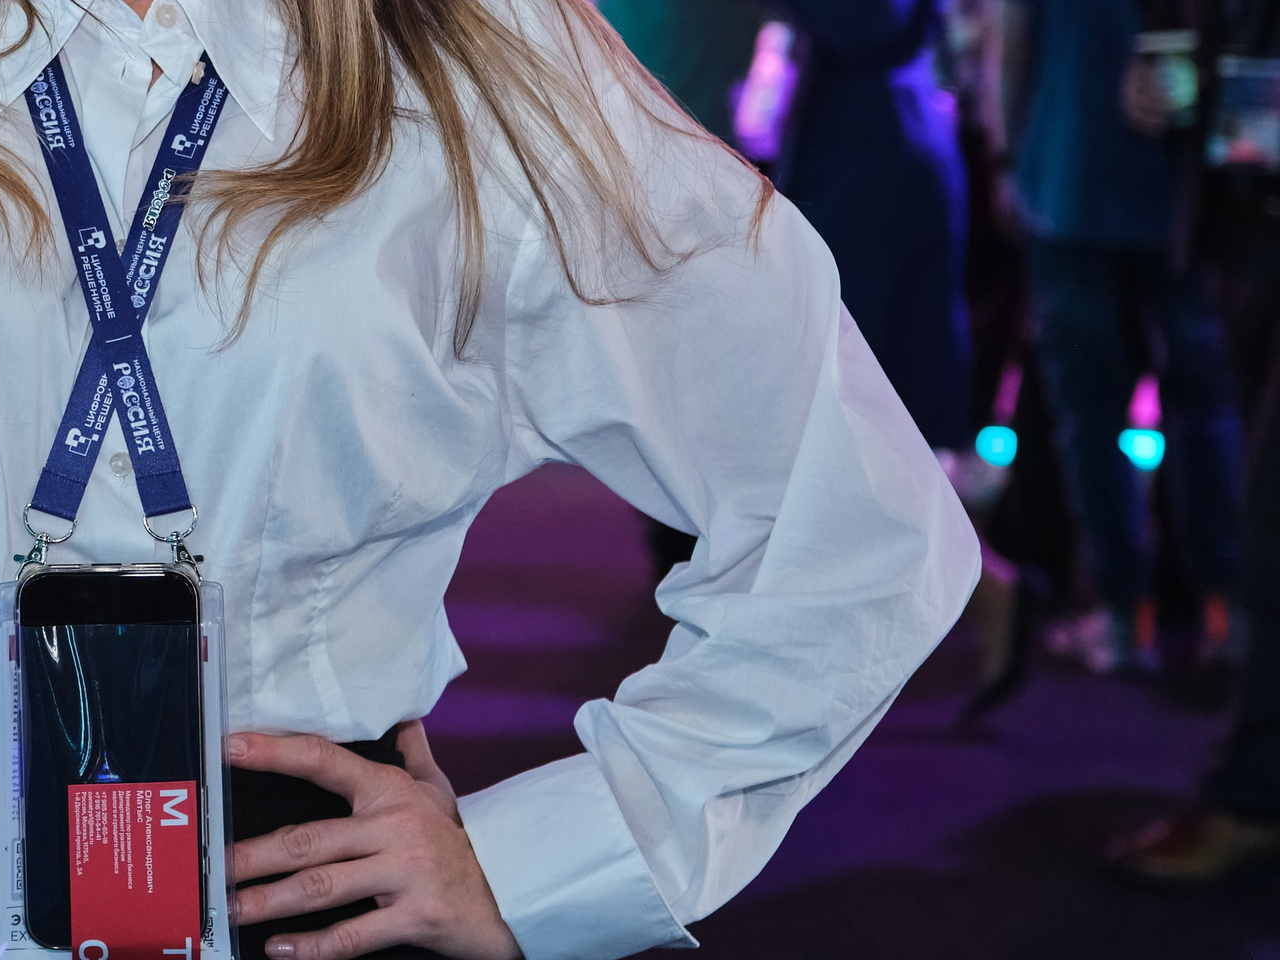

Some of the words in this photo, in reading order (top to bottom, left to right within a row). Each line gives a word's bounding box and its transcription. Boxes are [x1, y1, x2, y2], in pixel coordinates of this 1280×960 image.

[47, 67, 70, 125] НАЦИОНАЛЬНЫЙ
[63, 124, 76, 148] ЦЕНТР
[190, 78, 218, 134] ЦИФРОВЫЕ
[130, 233, 167, 309] ОССИЯ
[135, 230, 148, 255] ЦЕНТР
[90, 254, 116, 319] ЦИФРОВЫЕ
[84, 372, 108, 428] ЦИФРОВ
[113, 362, 155, 455] РОССИЯ
[132, 359, 159, 425] НАЦИОНАЛЬНЫЙ
[152, 424, 165, 450] ЦЕНТР
[136, 790, 144, 824] Матыс
[144, 790, 153, 814] Олег
[145, 816, 154, 894] Александрович
